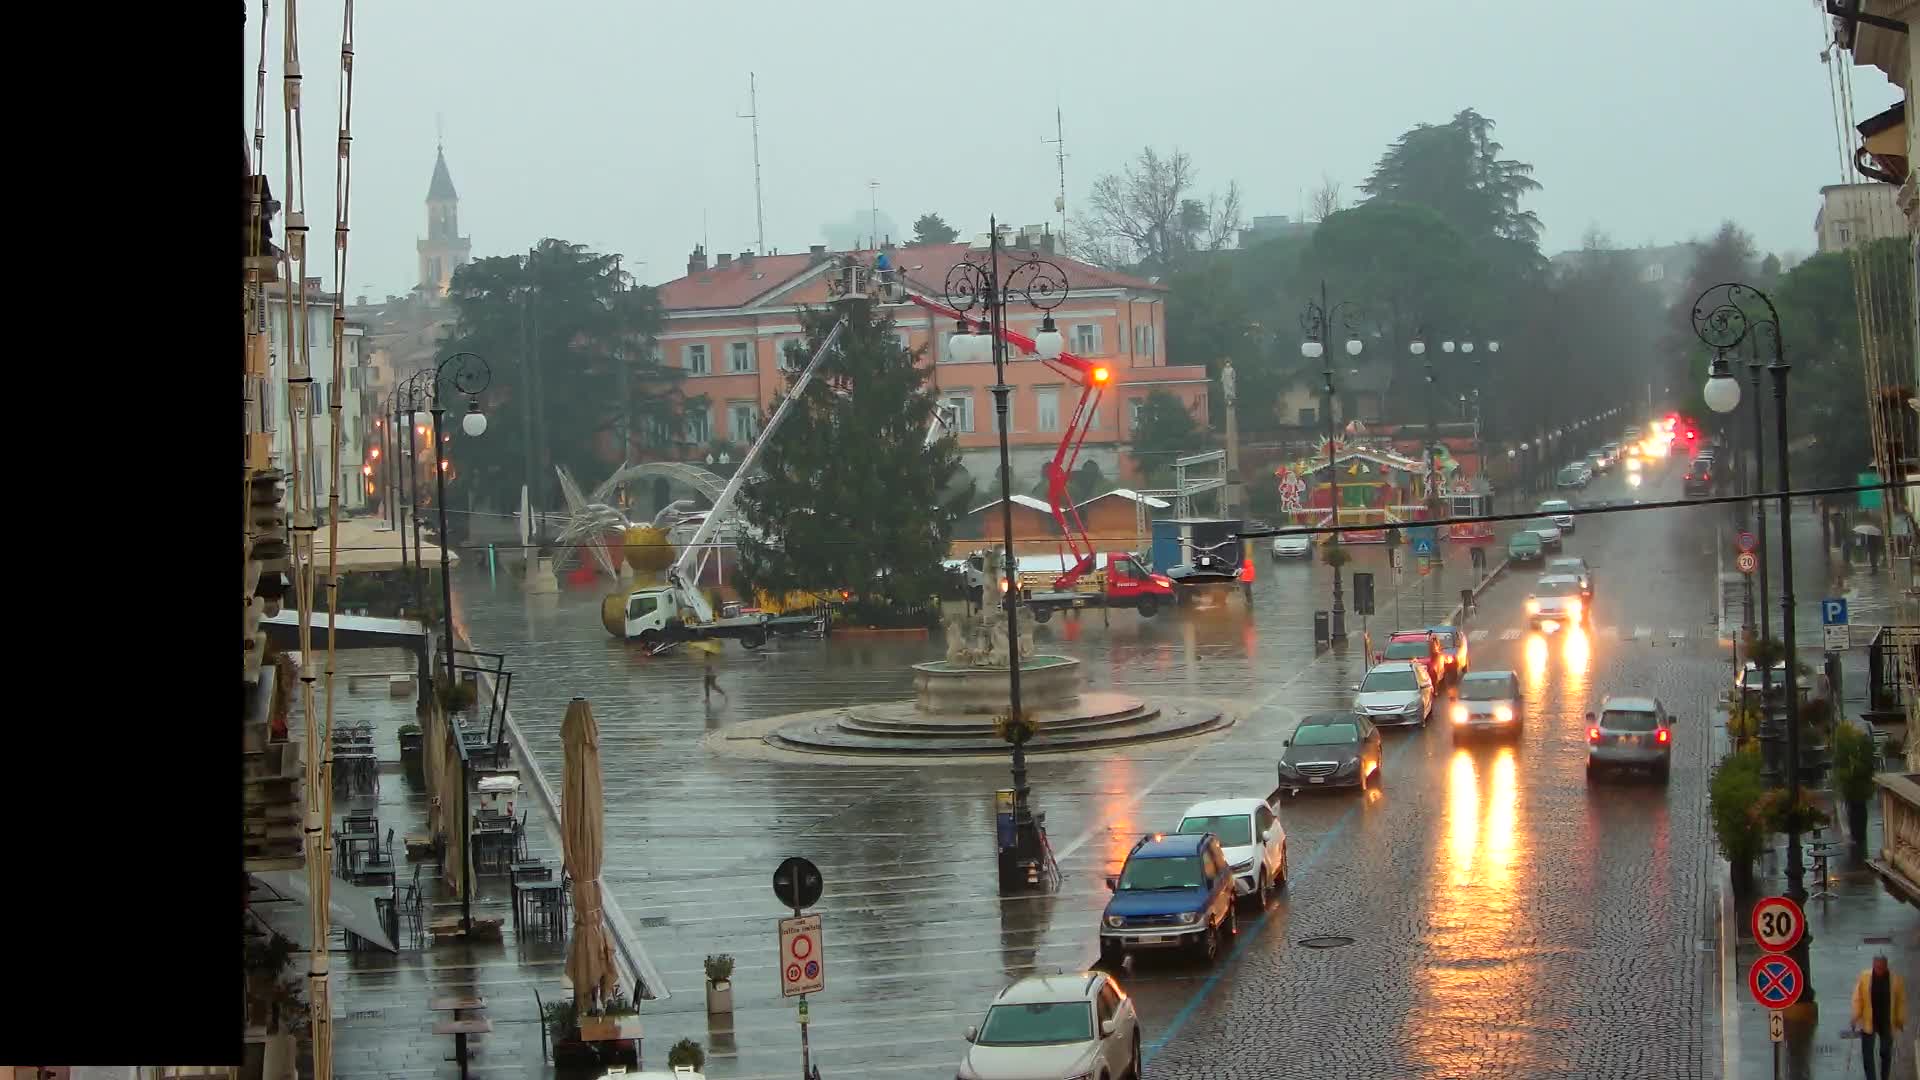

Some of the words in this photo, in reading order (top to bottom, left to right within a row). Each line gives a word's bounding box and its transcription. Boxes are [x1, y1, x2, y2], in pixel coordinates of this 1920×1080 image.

[1742, 557, 1753, 567] 20
[1827, 602, 1842, 622] P
[1762, 911, 1792, 938] 30
